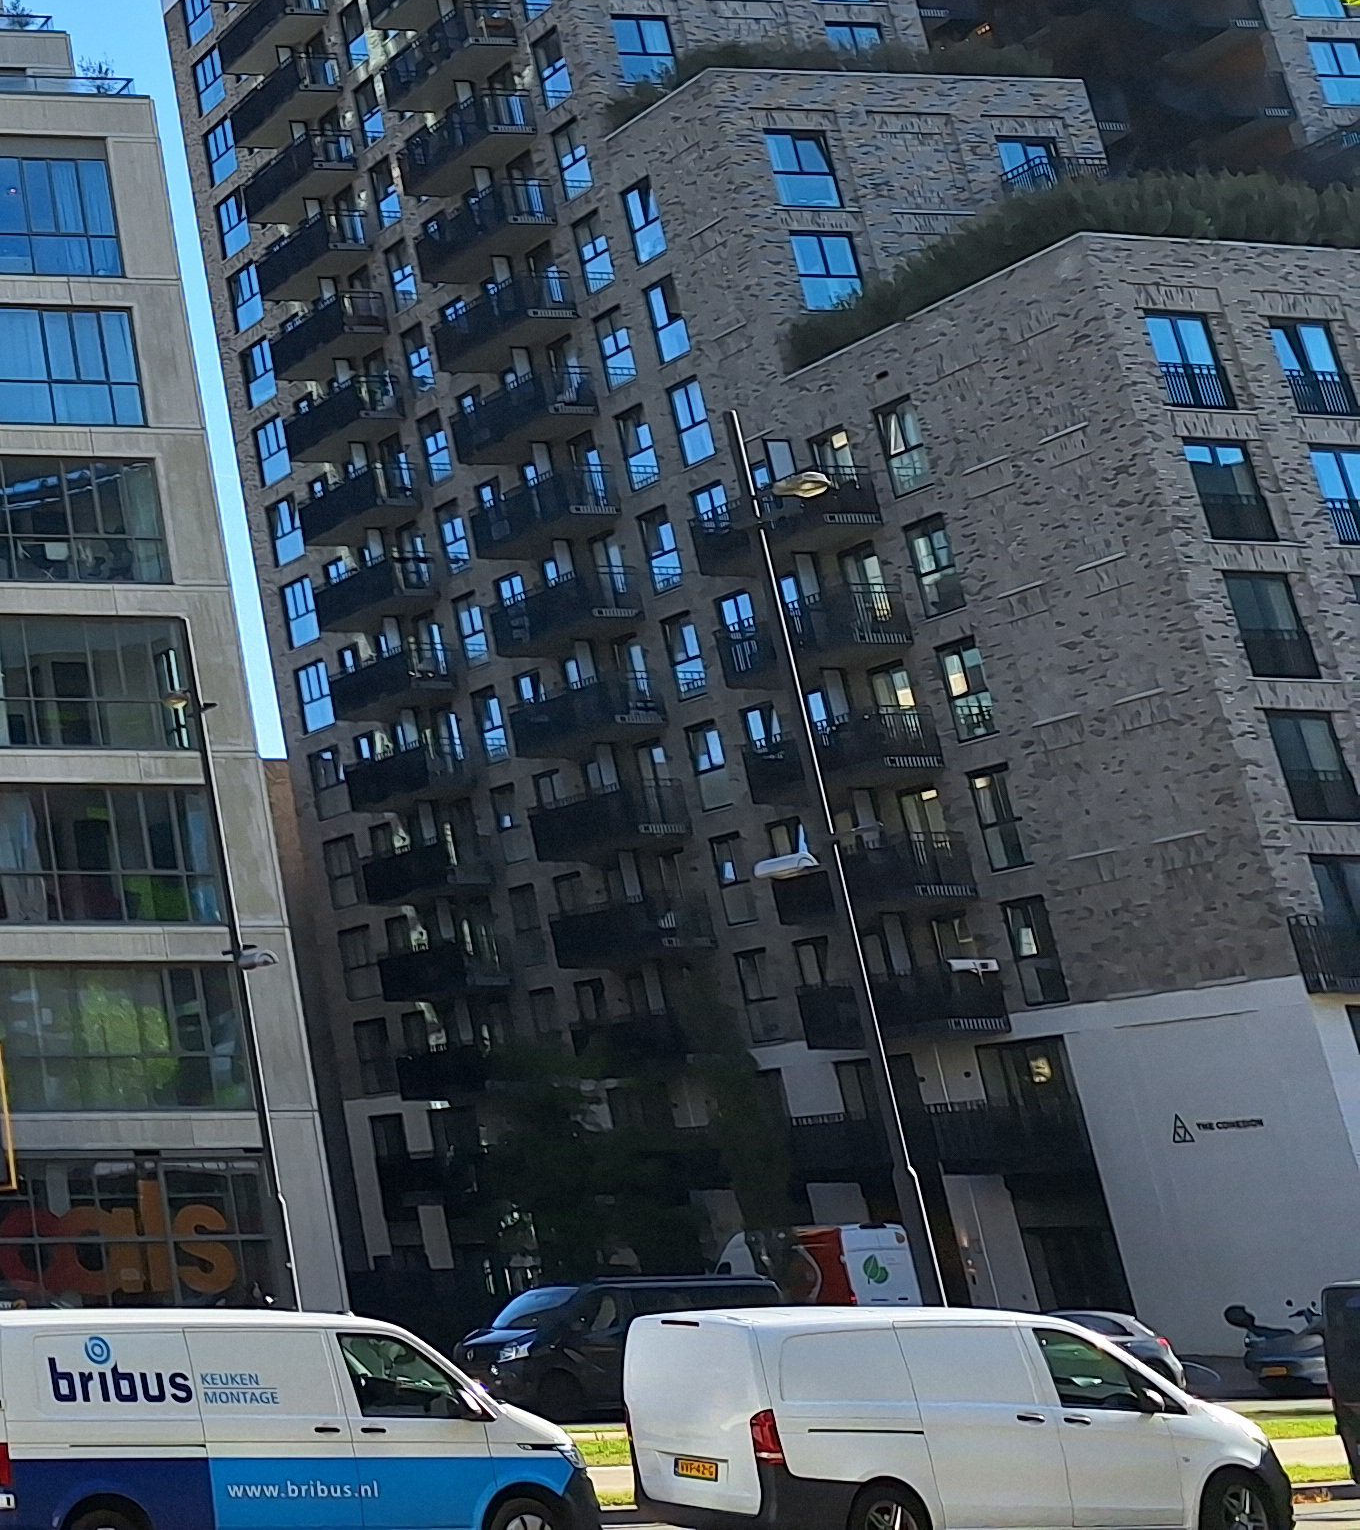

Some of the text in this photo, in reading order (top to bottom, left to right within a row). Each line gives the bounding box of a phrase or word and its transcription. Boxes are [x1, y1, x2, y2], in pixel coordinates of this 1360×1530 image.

[47, 1356, 194, 1404] bribus
[200, 1372, 260, 1387] KEUKEN
[203, 1390, 280, 1405] MONTAGE
[227, 1479, 380, 1499] www.bribus.nl
